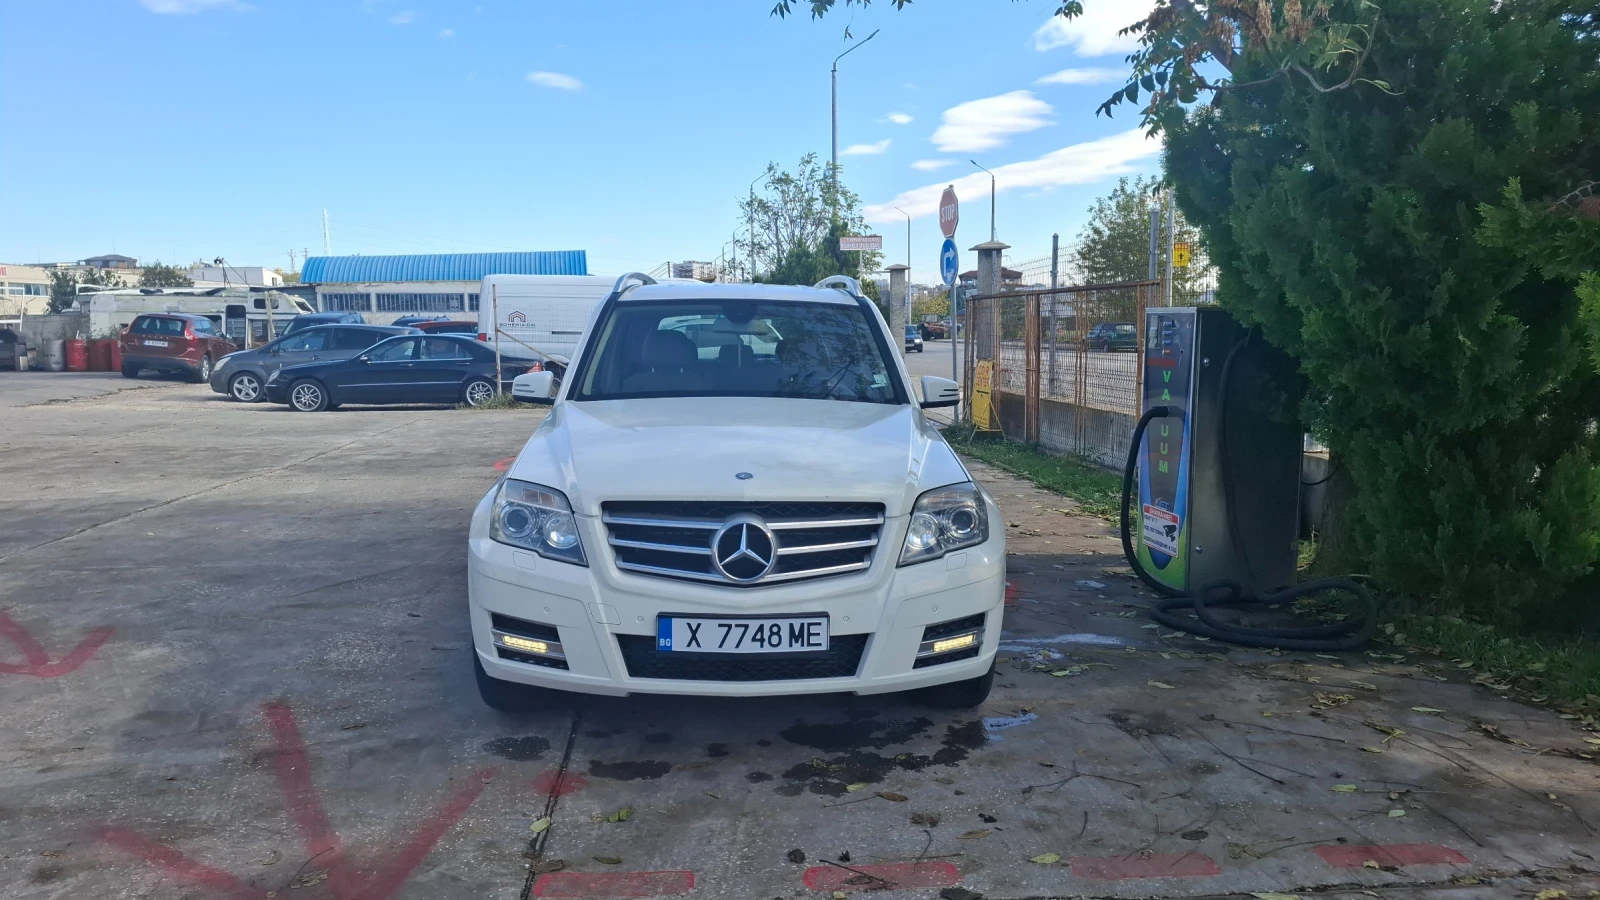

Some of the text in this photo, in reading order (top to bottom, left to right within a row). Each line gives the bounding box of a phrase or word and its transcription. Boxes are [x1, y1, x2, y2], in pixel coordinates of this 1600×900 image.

[941, 203, 955, 223] STOP
[1158, 370, 1172, 474] VAUUM
[659, 622, 822, 649] BG X 7748 ME
